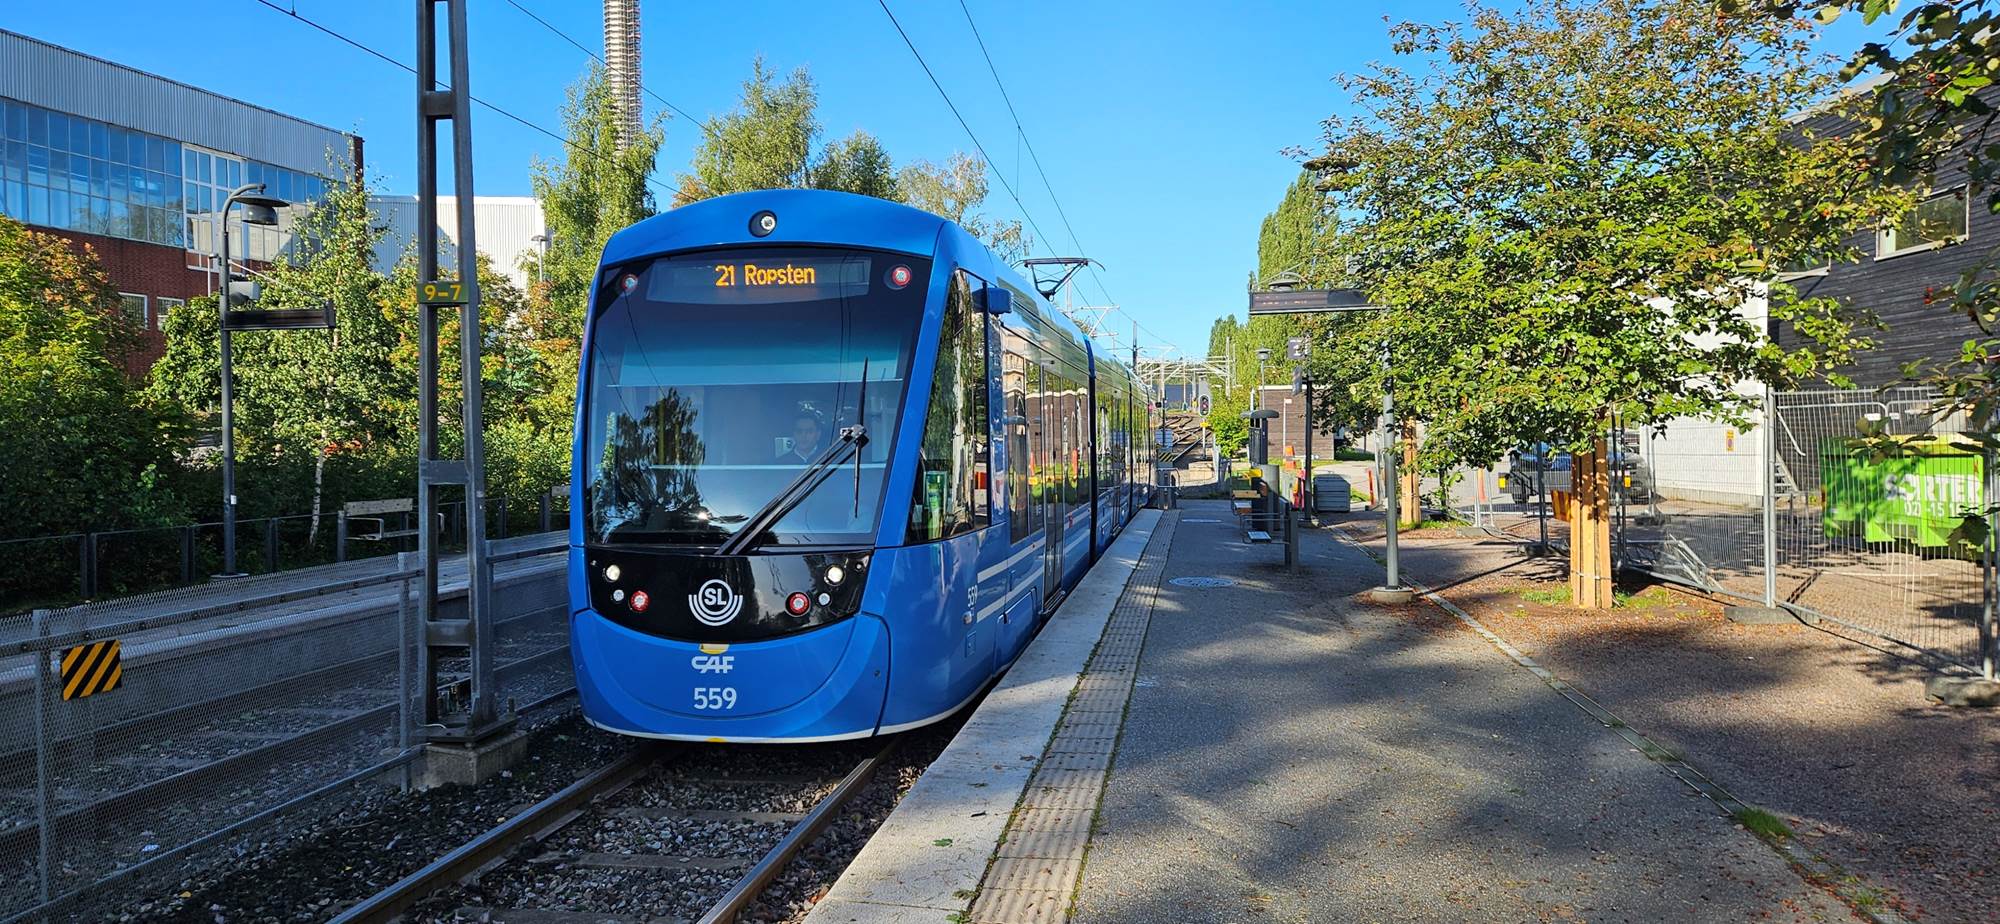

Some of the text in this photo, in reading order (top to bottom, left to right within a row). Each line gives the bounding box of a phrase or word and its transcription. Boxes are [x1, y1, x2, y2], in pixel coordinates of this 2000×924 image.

[715, 264, 815, 286] 21 Ropsten
[424, 284, 462, 301] 9-7
[704, 587, 727, 606] SL
[967, 584, 978, 608] 559
[691, 655, 735, 674] CAF
[693, 686, 738, 710] 559
